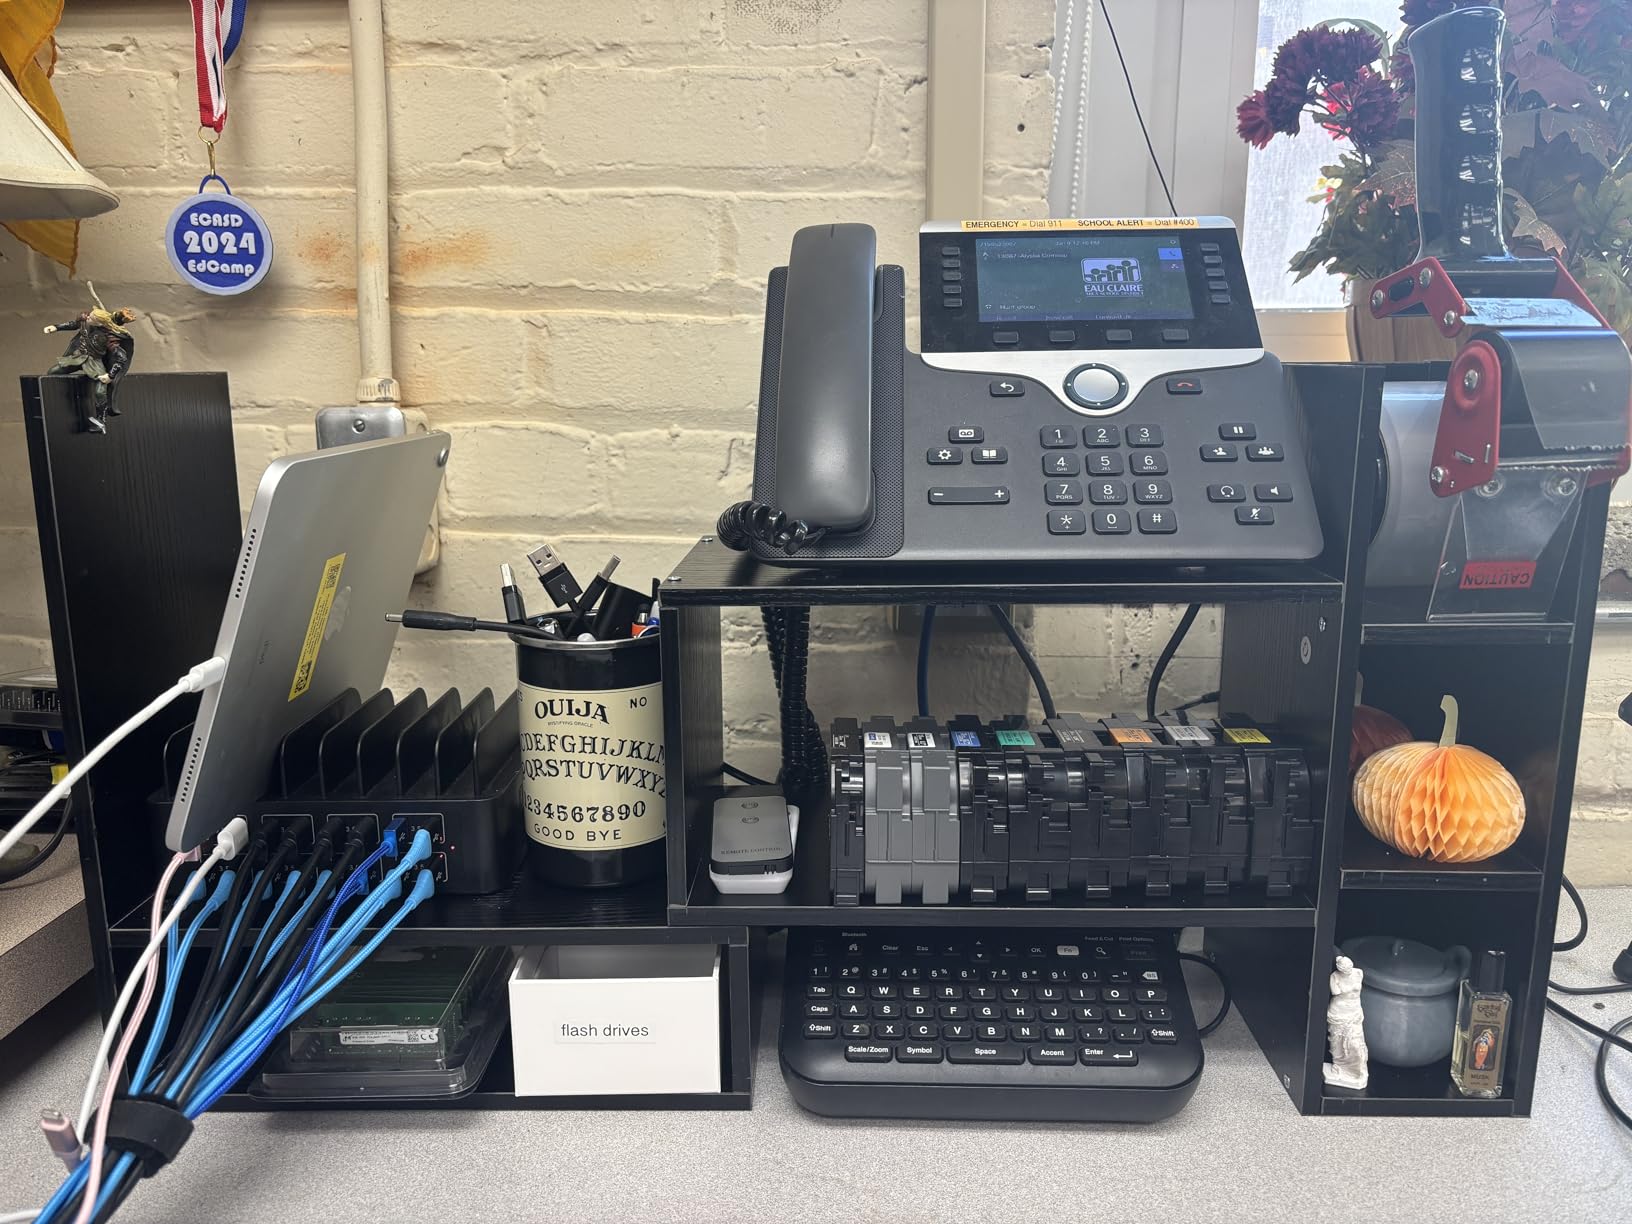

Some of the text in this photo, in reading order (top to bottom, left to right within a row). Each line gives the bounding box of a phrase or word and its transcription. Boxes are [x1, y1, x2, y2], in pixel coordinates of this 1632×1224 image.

[965, 220, 1019, 228] EMERGENCY
[1029, 219, 1046, 227] Dial
[1047, 219, 1062, 227] 911
[1116, 218, 1144, 226] ALERT
[1154, 218, 1171, 226] Dial
[1173, 218, 1194, 226] #400
[183, 230, 256, 254] 2024
[187, 259, 254, 277] EdCamp
[1084, 284, 1143, 292] EAU CLAIRE
[1055, 428, 1149, 438] 1 2 3
[1057, 456, 1153, 466] 4 5 6
[1060, 484, 1157, 494] 7 8 9
[1107, 514, 1161, 524] 0 #
[1463, 573, 1530, 585] CAUTION
[534, 697, 648, 724] OUIJA NO
[534, 823, 621, 842] GOOD BYE
[561, 1023, 649, 1037] flash drives
